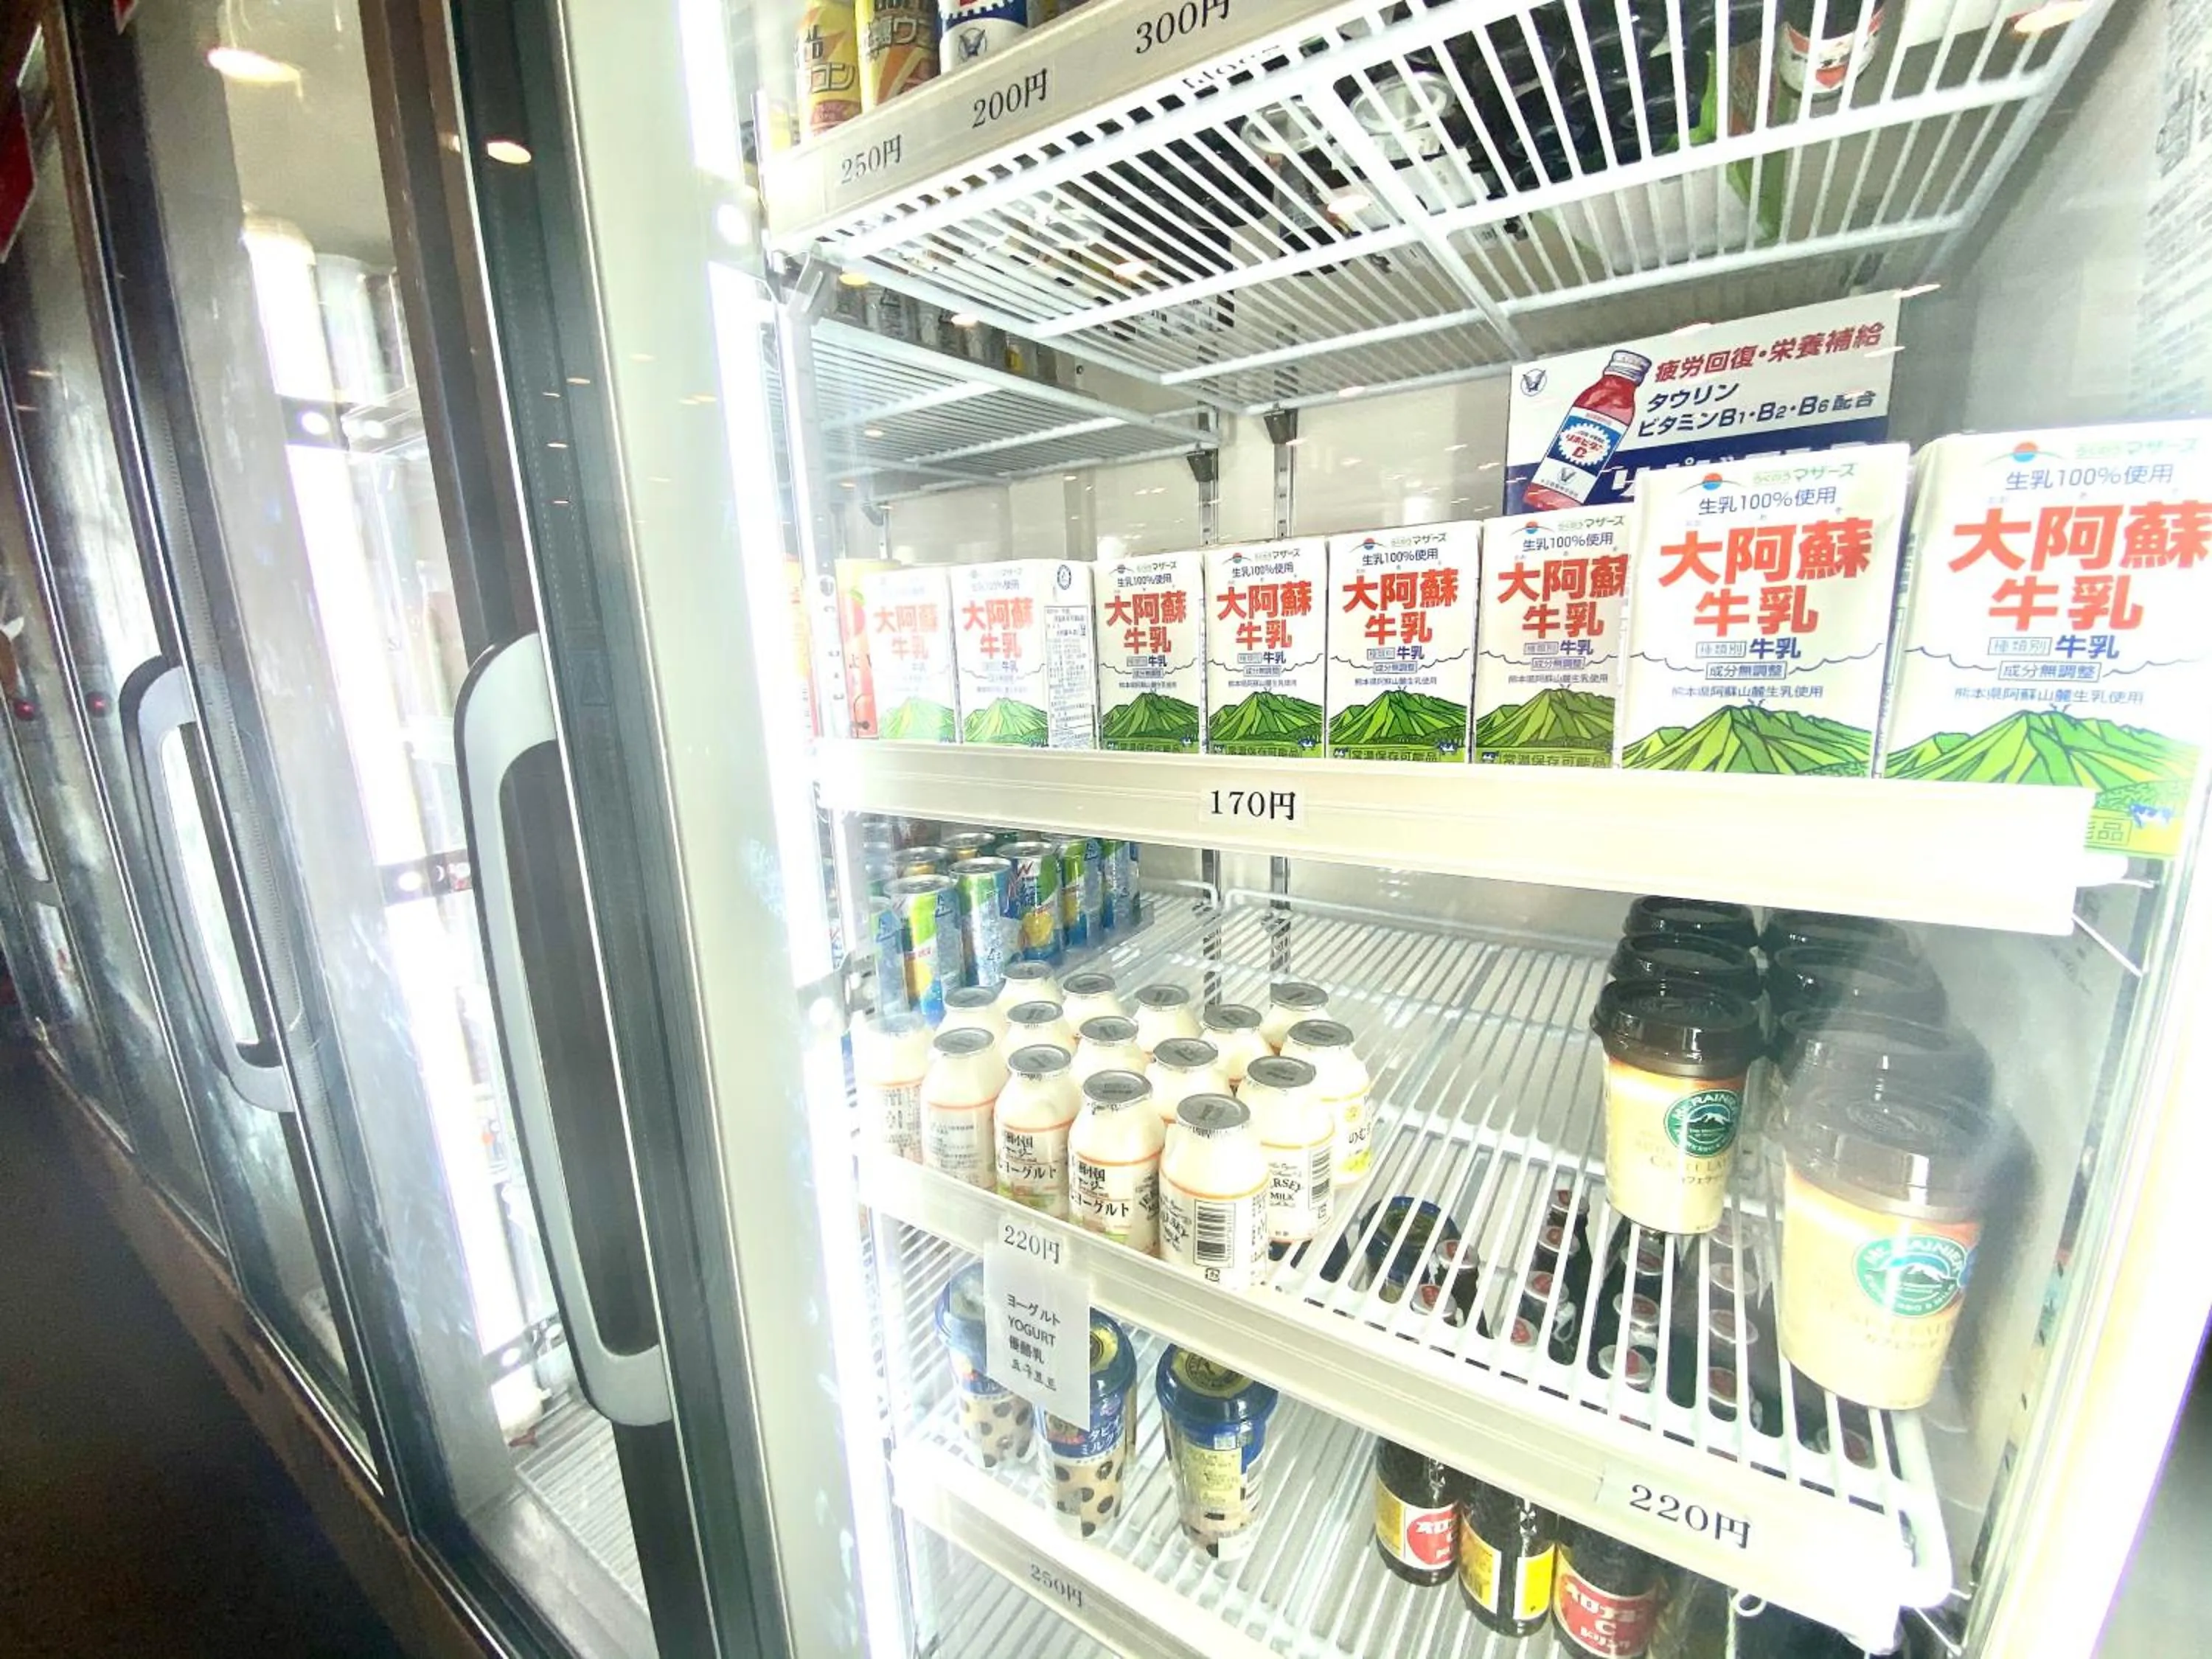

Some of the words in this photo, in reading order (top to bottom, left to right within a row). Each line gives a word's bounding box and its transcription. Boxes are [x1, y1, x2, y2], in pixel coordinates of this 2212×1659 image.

[1134, 0, 1230, 54] 300円
[971, 67, 1048, 130] 200円
[841, 133, 903, 186] 250円
[1654, 321, 1885, 384] 疲労回復・栄養補給
[1646, 383, 1741, 414] タウリン
[2005, 463, 2173, 491] 生乳100%使用
[1699, 486, 1837, 515] 生乳100%使用
[1523, 532, 1613, 552] 生乳100%使用
[1658, 516, 1874, 588] 大阿蘇
[1948, 500, 2212, 573] 大阿蘇
[1232, 562, 1294, 578] 生乳100%使用
[1363, 548, 1439, 566] 生乳100%使用
[1342, 567, 1458, 613] 大阿蘇
[1498, 553, 1628, 603] 大阿蘇
[961, 597, 1034, 633] 大阿蘇
[1105, 591, 1187, 627] 大阿蘇
[1217, 580, 1312, 621] 大阿蘇
[1694, 585, 1819, 637] 牛乳
[1988, 575, 2144, 632] 牛乳
[1236, 619, 1293, 651] 牛乳
[1364, 611, 1433, 646] 牛乳
[1523, 601, 1604, 639] 牛乳
[980, 633, 1023, 661] 牛乳
[1124, 626, 1172, 655] 牛乳
[1397, 645, 1424, 661] 牛乳
[1559, 639, 1594, 655] 牛乳
[1749, 637, 1801, 660] 牛乳
[2055, 634, 2120, 659] 牛乳
[1210, 790, 1295, 821] 170円
[1004, 1225, 1061, 1265] 220円
[1006, 1293, 1061, 1326] ヨーグルト
[1008, 1315, 1056, 1348] YOGURT
[1630, 1484, 1753, 1549] 220円
[1030, 1563, 1085, 1608] 250円
